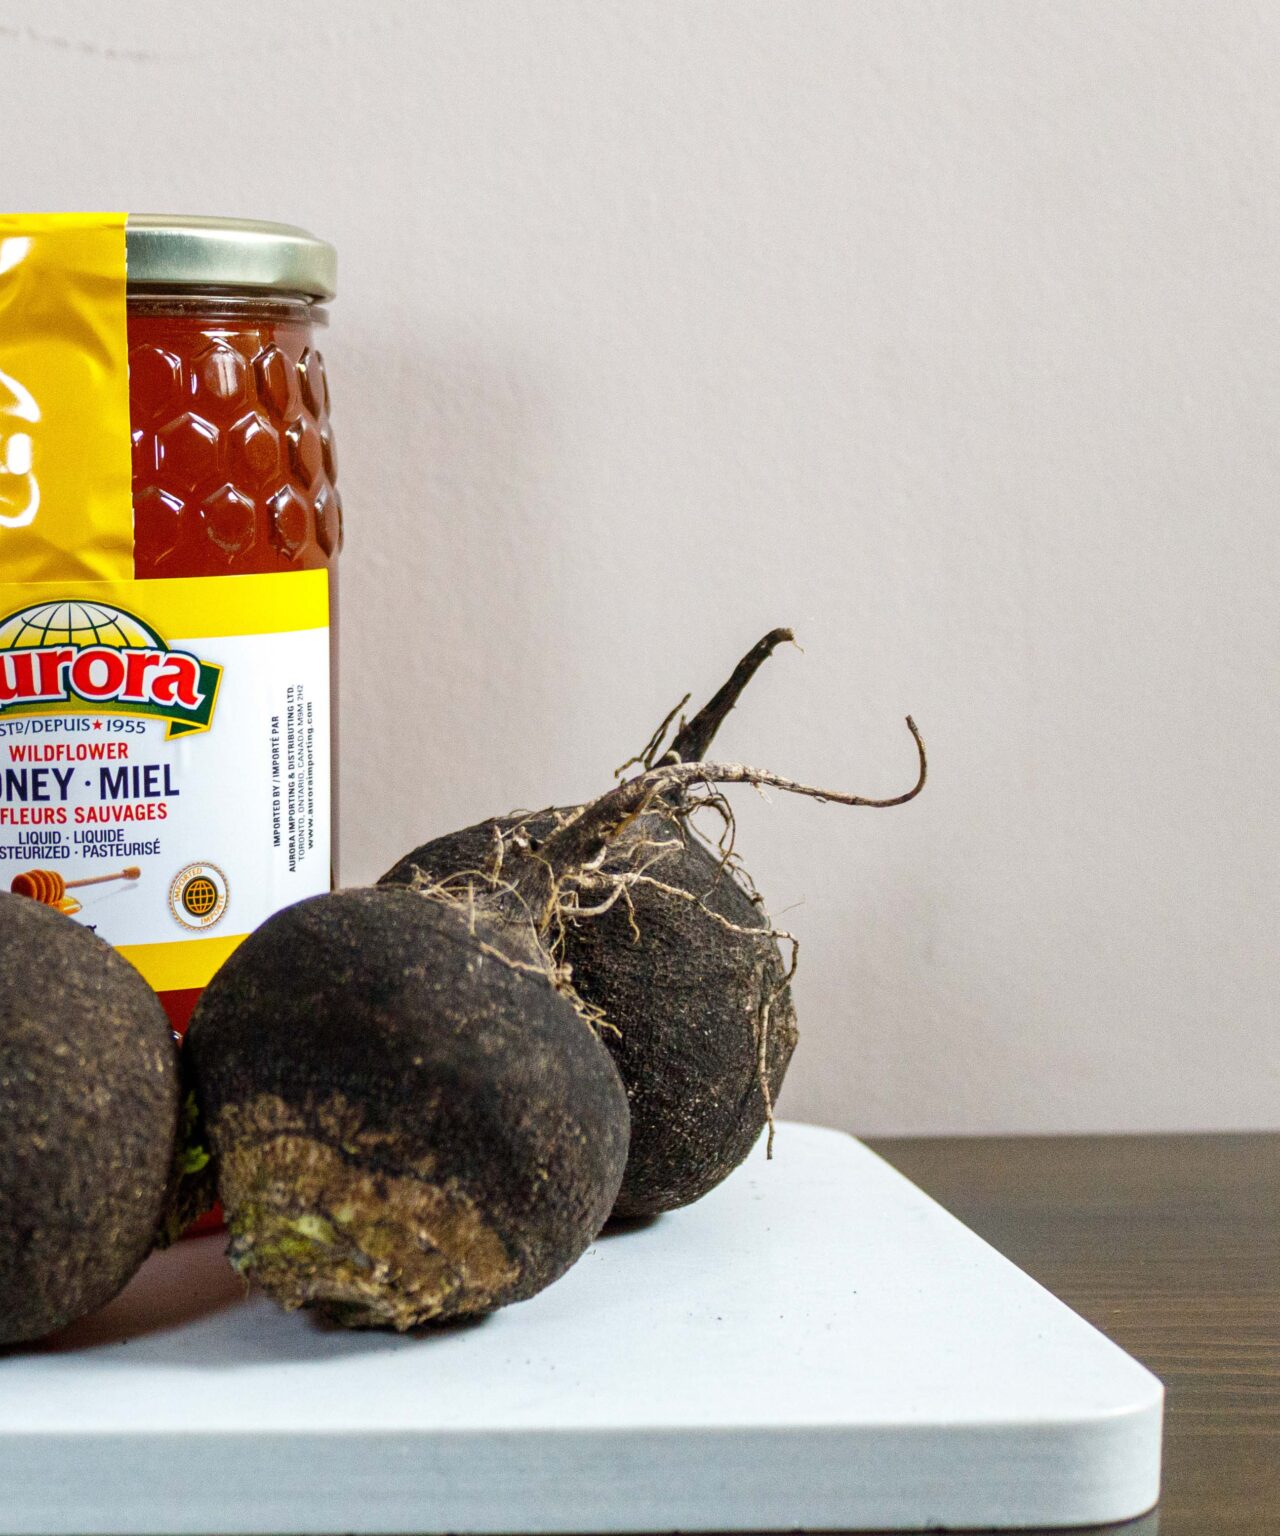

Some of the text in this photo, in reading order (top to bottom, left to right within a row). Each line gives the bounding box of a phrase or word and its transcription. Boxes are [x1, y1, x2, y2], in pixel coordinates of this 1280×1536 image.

[106, 719, 146, 734] 1955
[271, 716, 279, 735] PAR
[287, 705, 295, 770] DISTRIBUTING
[9, 742, 128, 762] WILDFLOWER
[269, 736, 280, 778] IMPORTÉ
[99, 764, 180, 800] MIEL
[272, 785, 280, 798] BY
[0, 807, 67, 825] FLEURS
[74, 803, 168, 824] SAUVAGES
[18, 829, 125, 845] LIQUID LIQUIDE
[82, 838, 161, 858] PASTEURISÉ
[175, 868, 202, 902] IMPORTED
